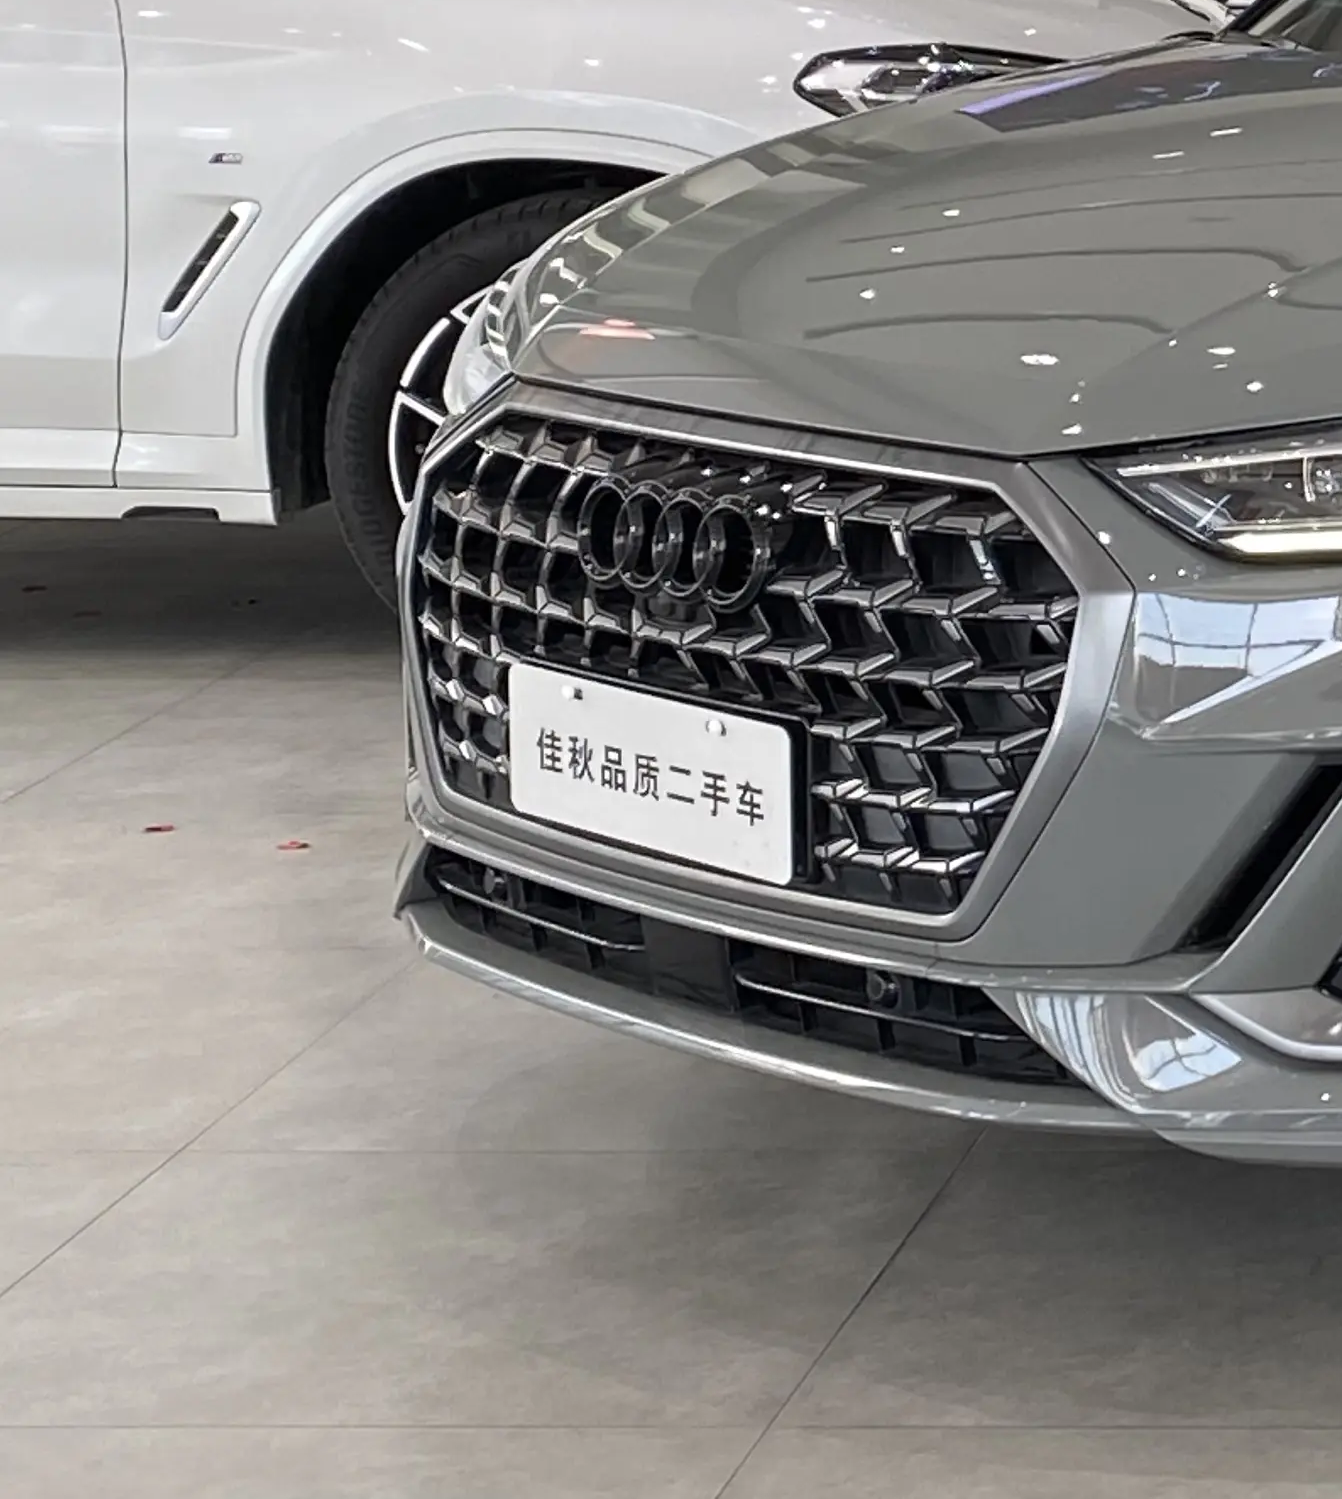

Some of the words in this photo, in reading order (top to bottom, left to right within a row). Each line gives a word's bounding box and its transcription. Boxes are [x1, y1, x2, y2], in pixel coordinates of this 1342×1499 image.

[535, 726, 765, 827] 佳秋品质二手车
